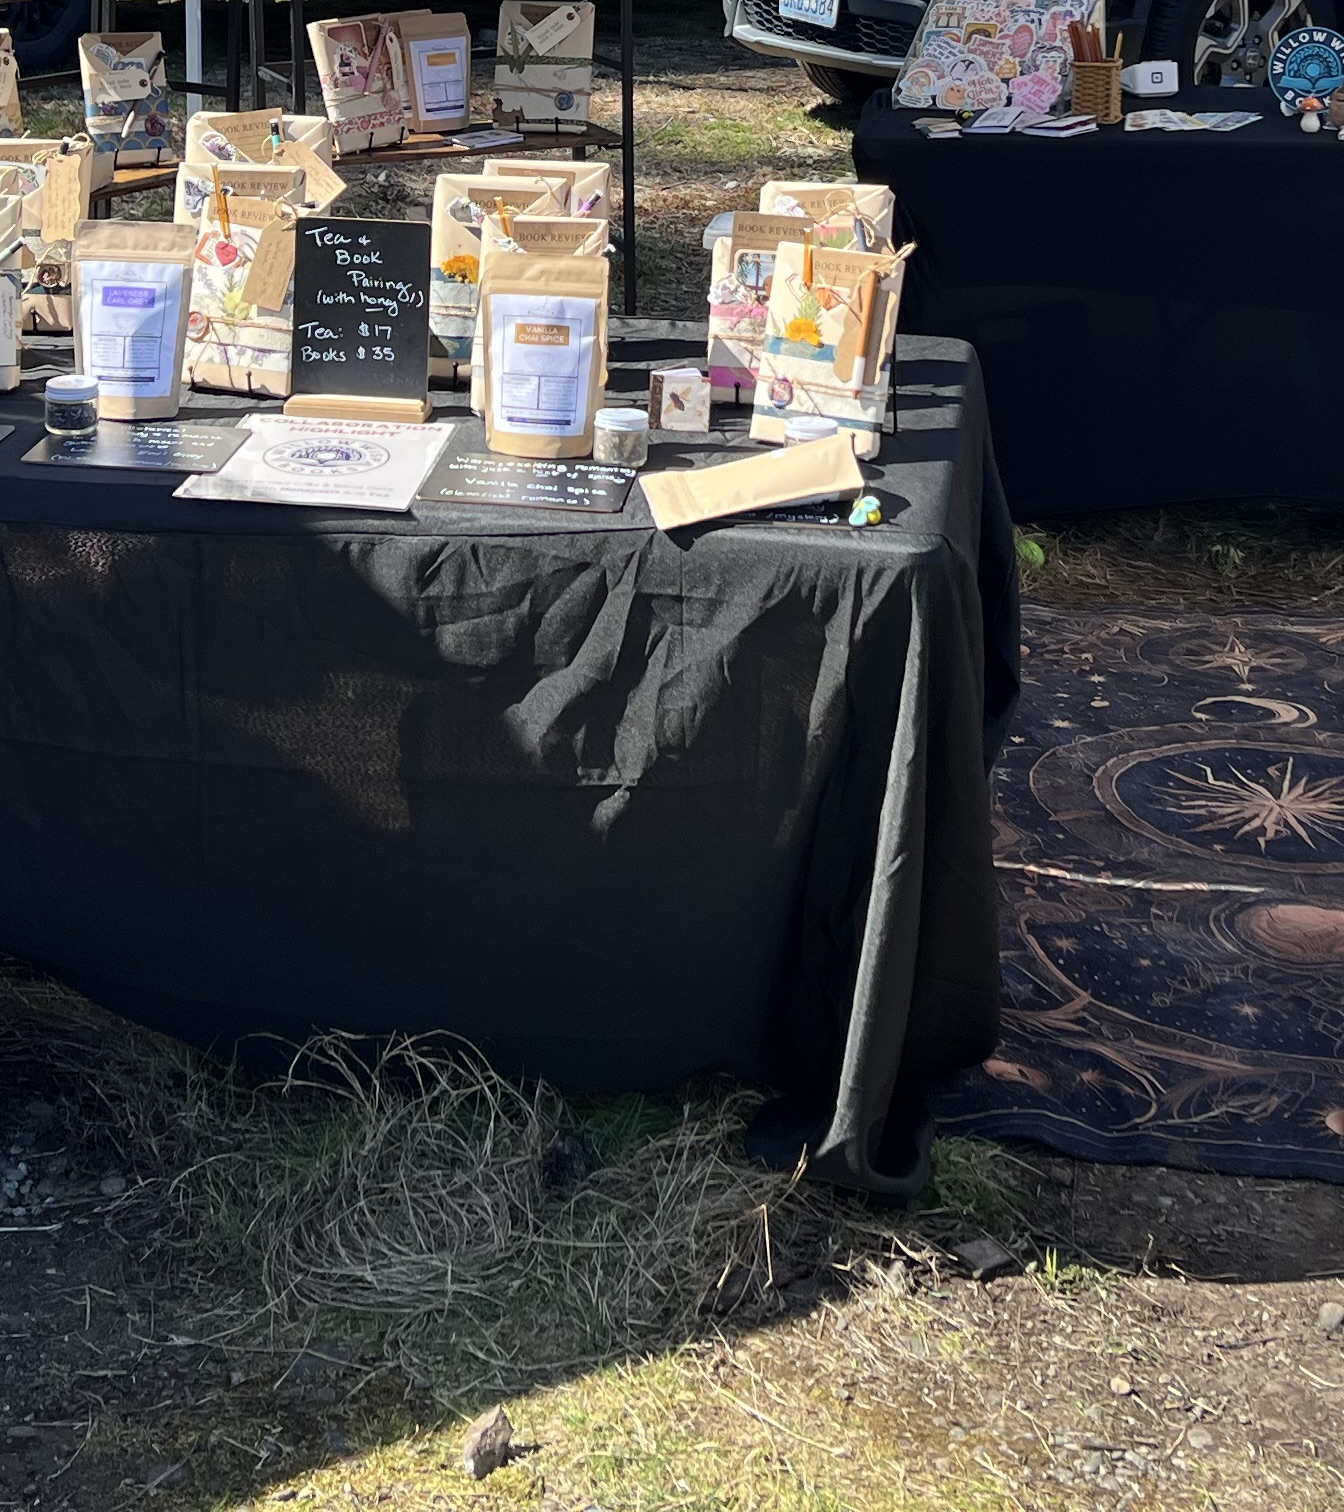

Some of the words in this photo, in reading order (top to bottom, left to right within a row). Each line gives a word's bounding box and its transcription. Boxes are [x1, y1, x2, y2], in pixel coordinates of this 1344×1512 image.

[1272, 31, 1327, 74] WILLOW
[242, 121, 271, 132] REVIE
[250, 181, 289, 191] REVIEW
[213, 206, 237, 218] BOK
[240, 210, 276, 222] REVIEW
[737, 223, 766, 234] BOOK
[305, 226, 351, 247] Tea
[519, 232, 547, 242] BOOK
[814, 261, 842, 273] BOOK
[347, 270, 412, 303] Pairing
[108, 289, 149, 298] LAVENDER
[316, 290, 355, 305] (with
[127, 297, 149, 305] GREY
[298, 321, 344, 339] Tea:
[525, 325, 559, 335] VANILLA
[518, 333, 541, 343] CHAI
[543, 335, 565, 344] SPICE
[300, 345, 346, 362] Books
[259, 417, 443, 432] COLLABORATION
[289, 426, 401, 437] HIGHLIGHT
[276, 462, 360, 475] BOOKS
